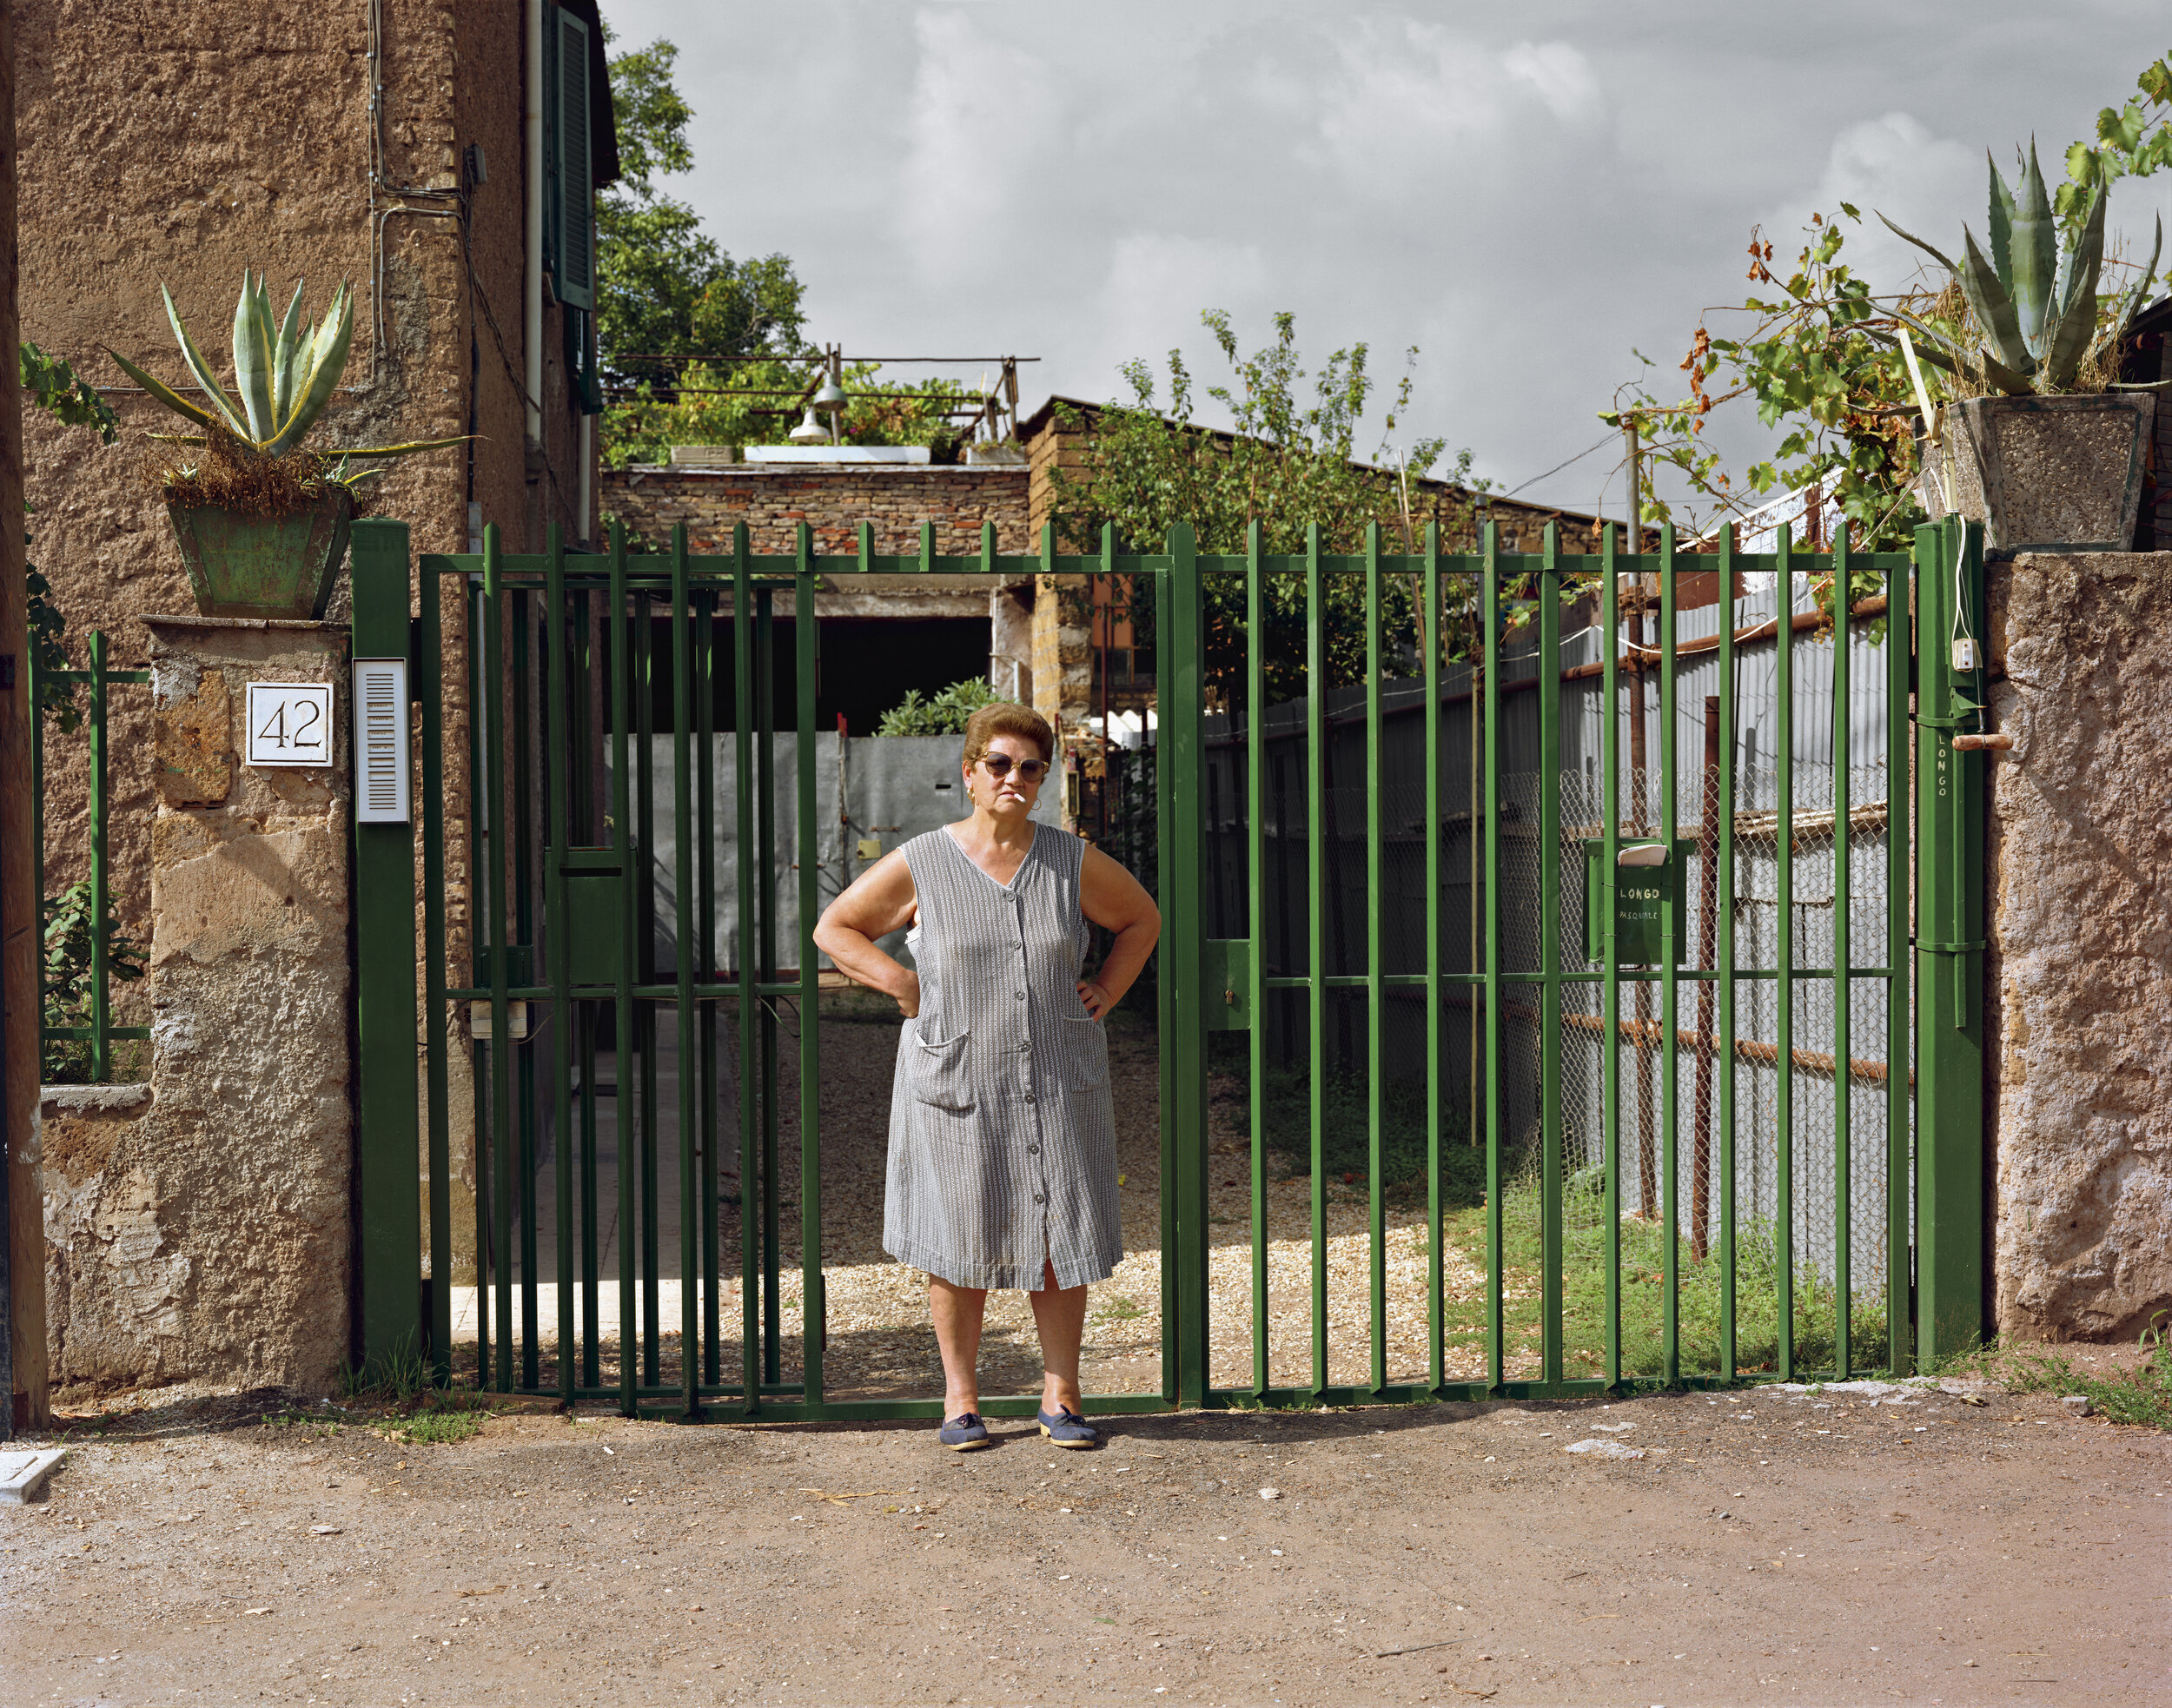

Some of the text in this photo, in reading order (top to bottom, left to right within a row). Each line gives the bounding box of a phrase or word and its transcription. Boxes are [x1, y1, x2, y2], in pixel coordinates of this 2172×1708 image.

[258, 700, 322, 748] 42
[1937, 734, 1947, 796] LONGO
[1620, 887, 1660, 900] LONGO
[1619, 910, 1659, 920] PASQUALE
